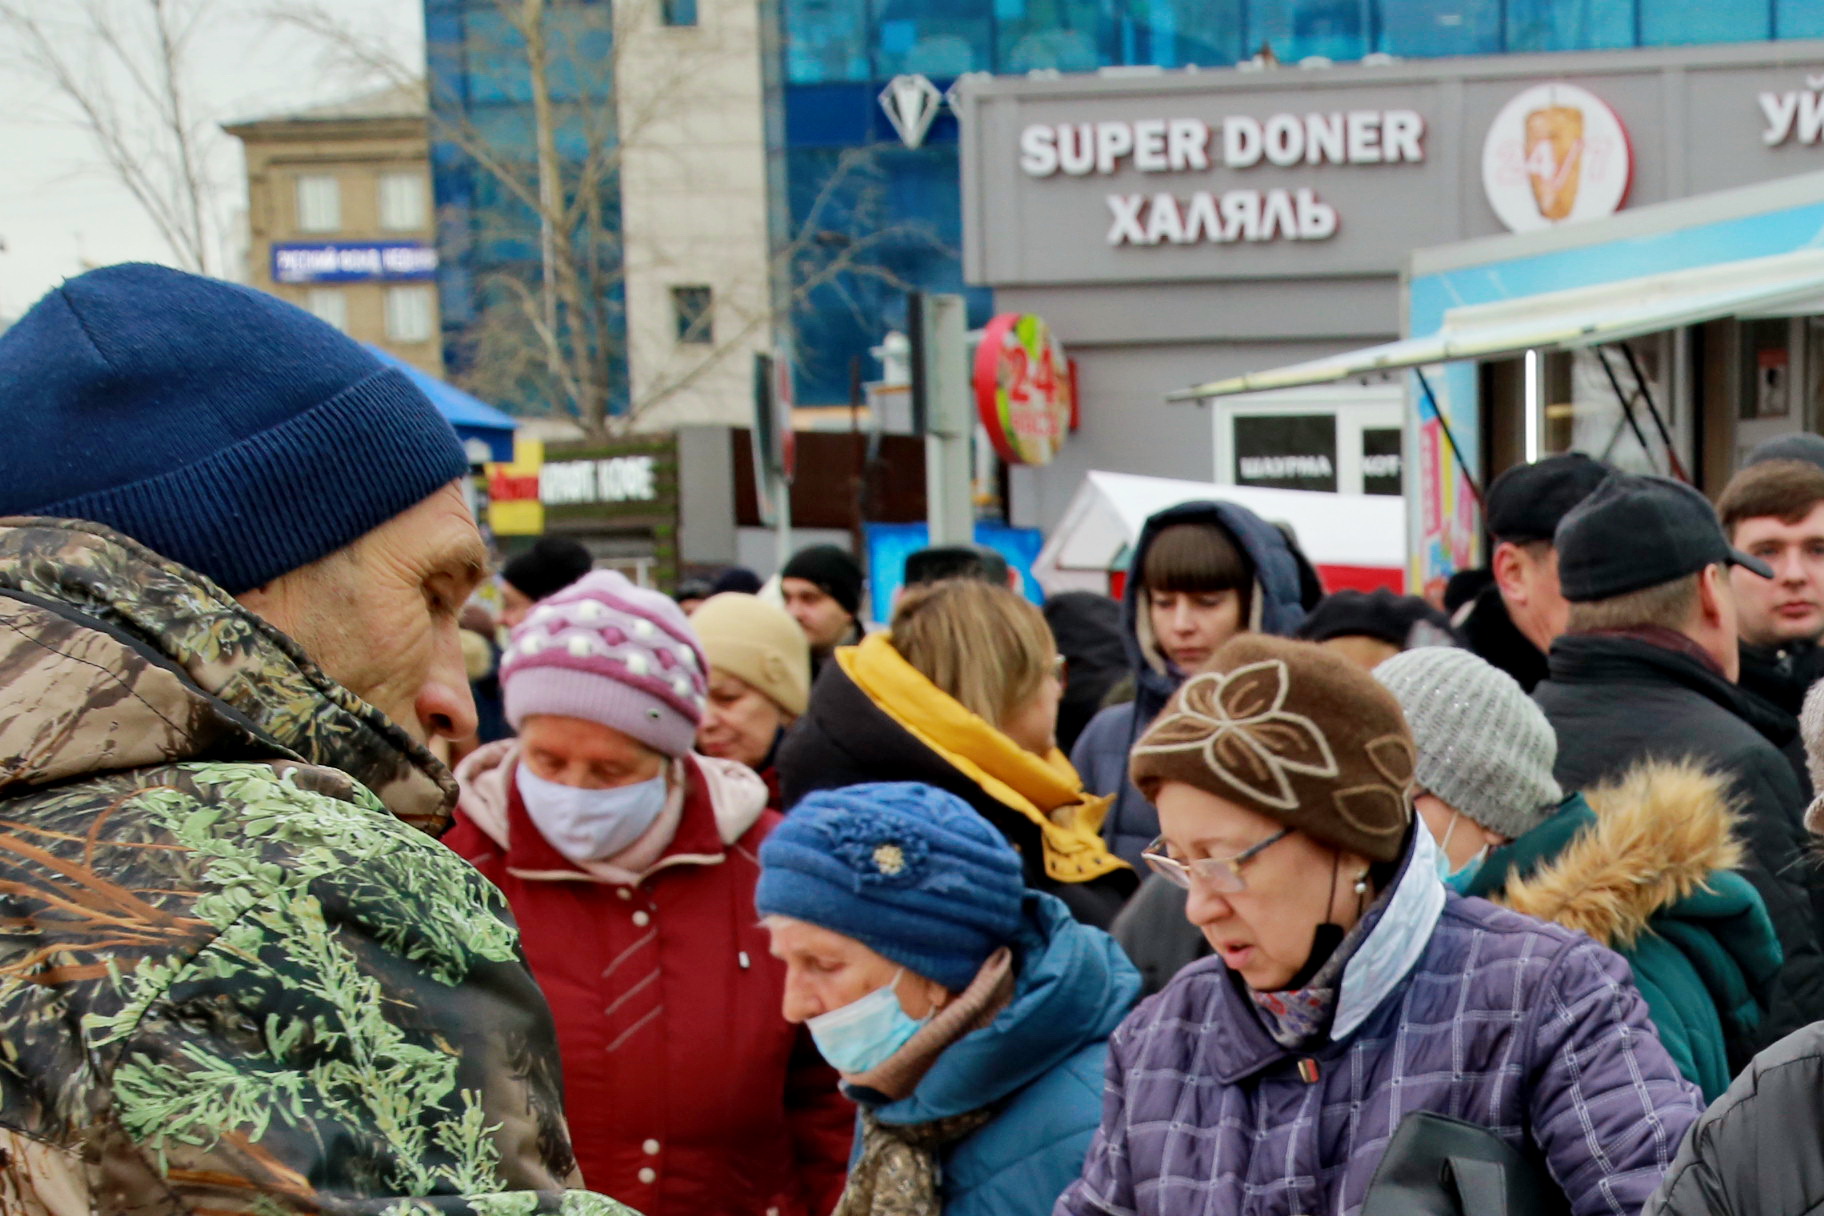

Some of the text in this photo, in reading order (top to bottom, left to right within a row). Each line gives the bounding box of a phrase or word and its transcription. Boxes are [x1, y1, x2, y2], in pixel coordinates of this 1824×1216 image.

[1019, 109, 1427, 177] SUPER DONER
[1106, 187, 1339, 246] ХАЛЯЛЬ
[1003, 345, 1056, 402] 24
[1239, 454, 1333, 479] ШАУРМА
